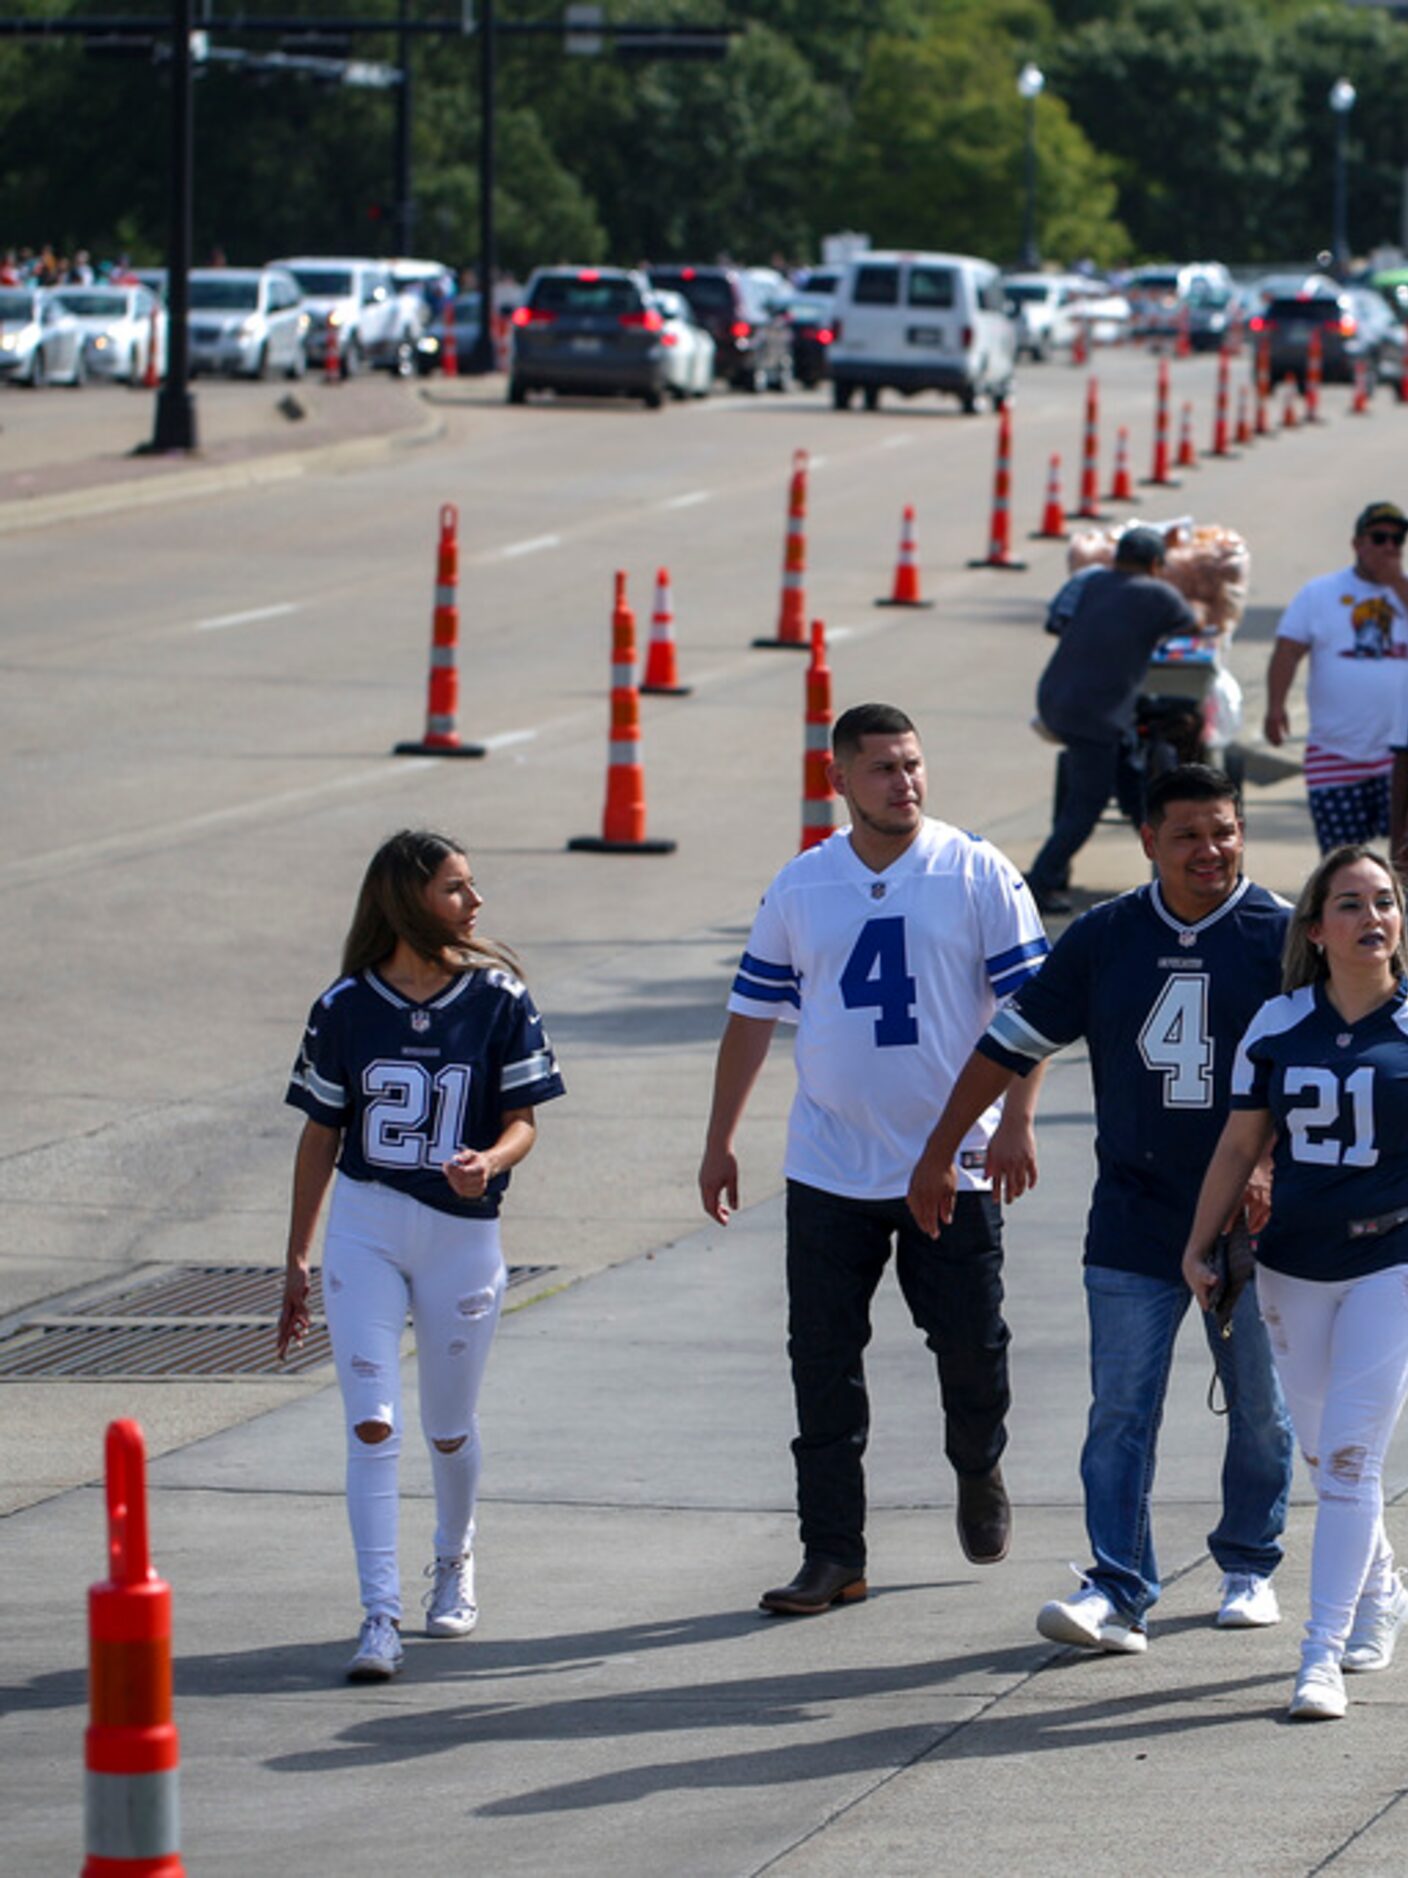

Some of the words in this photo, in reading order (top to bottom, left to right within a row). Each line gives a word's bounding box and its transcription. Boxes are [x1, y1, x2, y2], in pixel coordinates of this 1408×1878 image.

[839, 915, 919, 1047] 4
[1136, 972, 1215, 1109] 4
[362, 1058, 471, 1170] 21
[1284, 1066, 1379, 1167] 21
